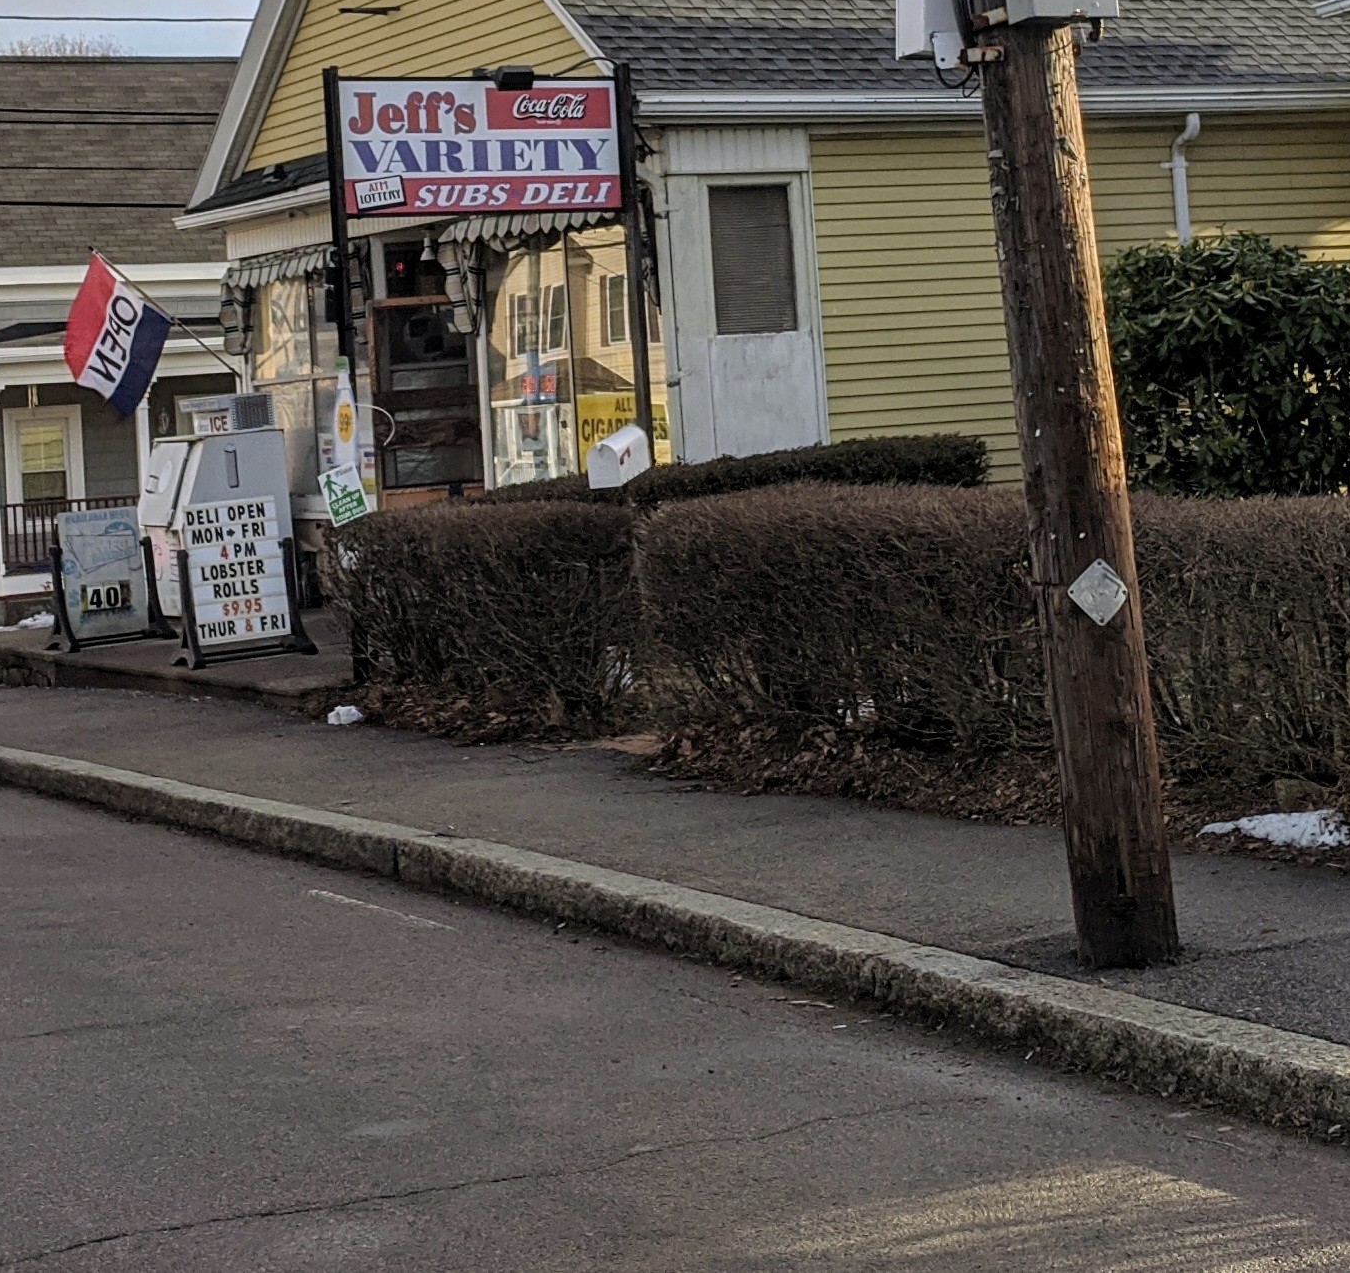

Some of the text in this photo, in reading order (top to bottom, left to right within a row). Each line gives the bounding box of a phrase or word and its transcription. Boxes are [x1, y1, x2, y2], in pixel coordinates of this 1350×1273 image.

[348, 90, 477, 135] Jeff's
[512, 93, 588, 119] Coca-Cola
[348, 137, 609, 174] VARIETY
[359, 189, 401, 204] LOTTERY
[369, 180, 389, 192] ATM
[414, 181, 613, 208] SUBS DELI
[614, 398, 633, 412] ALL
[209, 415, 229, 433] ICE
[186, 503, 266, 526] DELI OPEN
[338, 501, 358, 513] AFTER
[191, 521, 266, 545] MON FRI
[220, 542, 257, 560] 4 PM
[201, 559, 266, 582] LOBSTER
[89, 586, 120, 609] 40
[213, 579, 260, 599] ROLLS
[222, 598, 263, 616] $9.95
[199, 614, 286, 639] THUR & FRI
